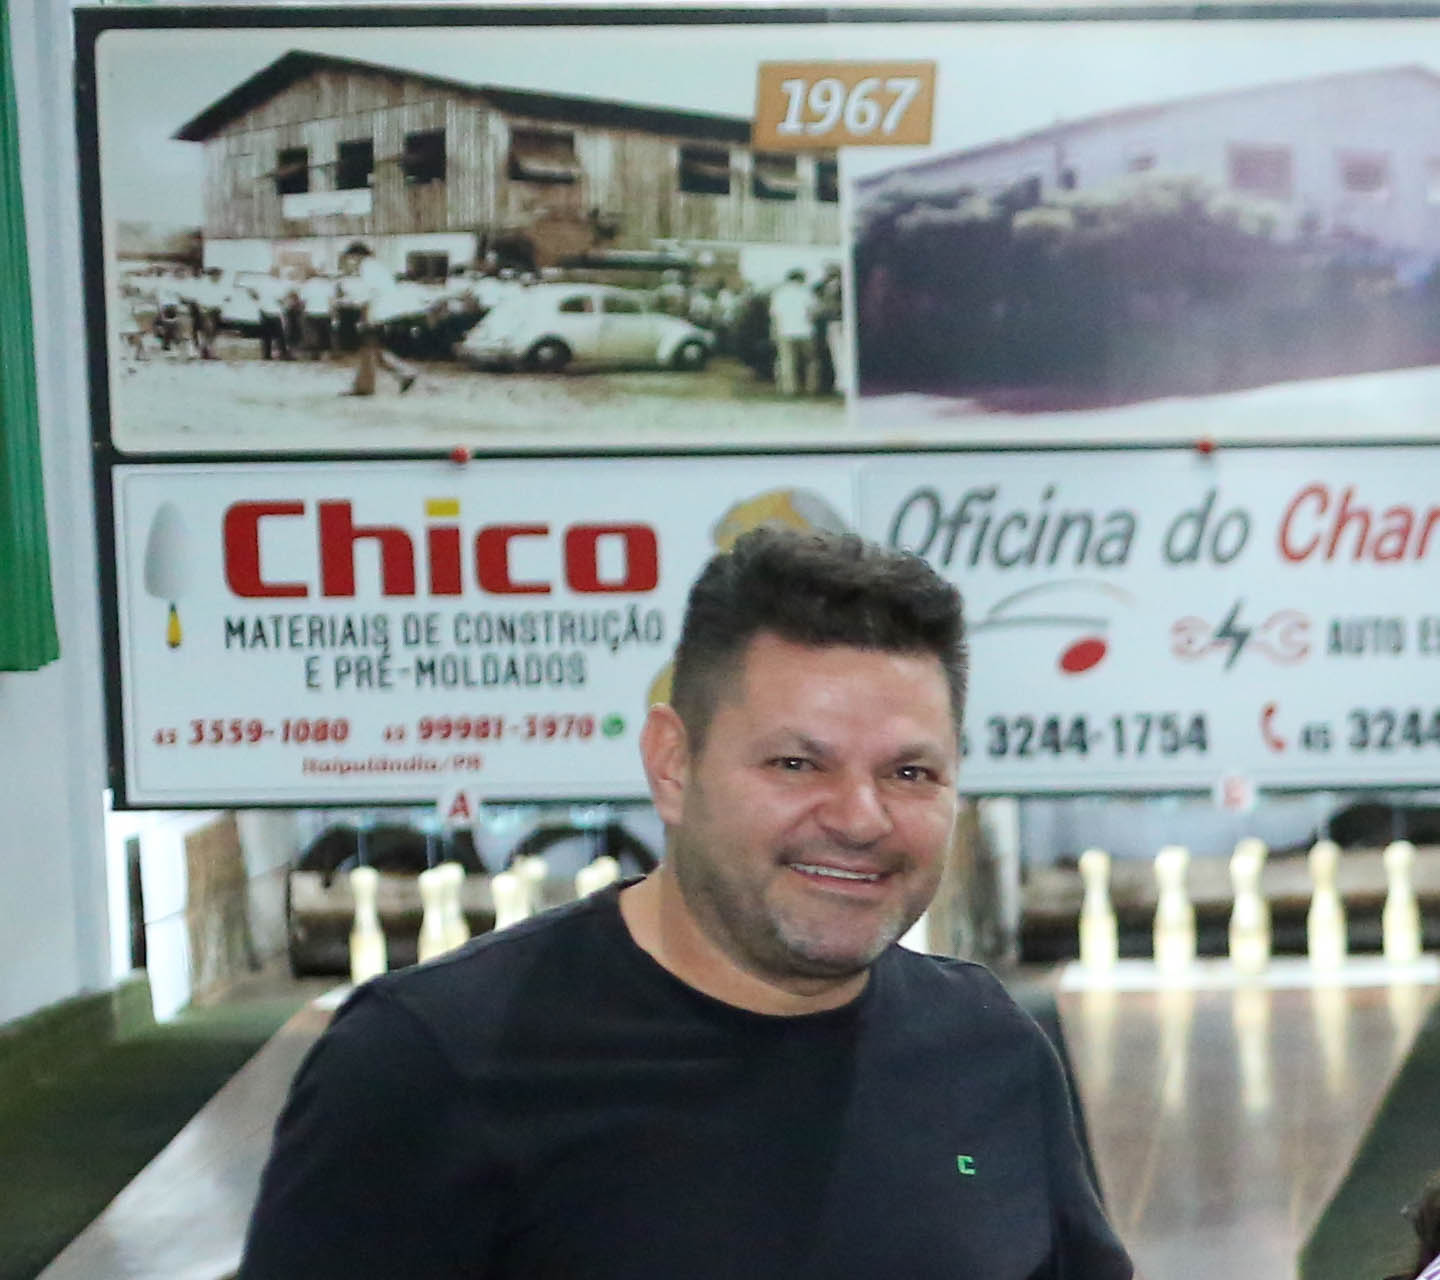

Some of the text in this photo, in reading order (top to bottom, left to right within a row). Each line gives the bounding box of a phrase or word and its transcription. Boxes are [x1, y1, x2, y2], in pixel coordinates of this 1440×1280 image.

[776, 77, 920, 136] 1967
[222, 497, 660, 600] Chico
[887, 485, 1137, 568] Oficina
[1162, 486, 1251, 567] do
[223, 602, 665, 656] MATERIAIS DE CONSTRUÇÃO
[1327, 617, 1404, 656] AUTO
[305, 648, 589, 690] E PRÉ-MOLDADOS
[986, 712, 1209, 757] 3244-1754
[1300, 724, 1333, 752] 45
[448, 791, 470, 818] A
